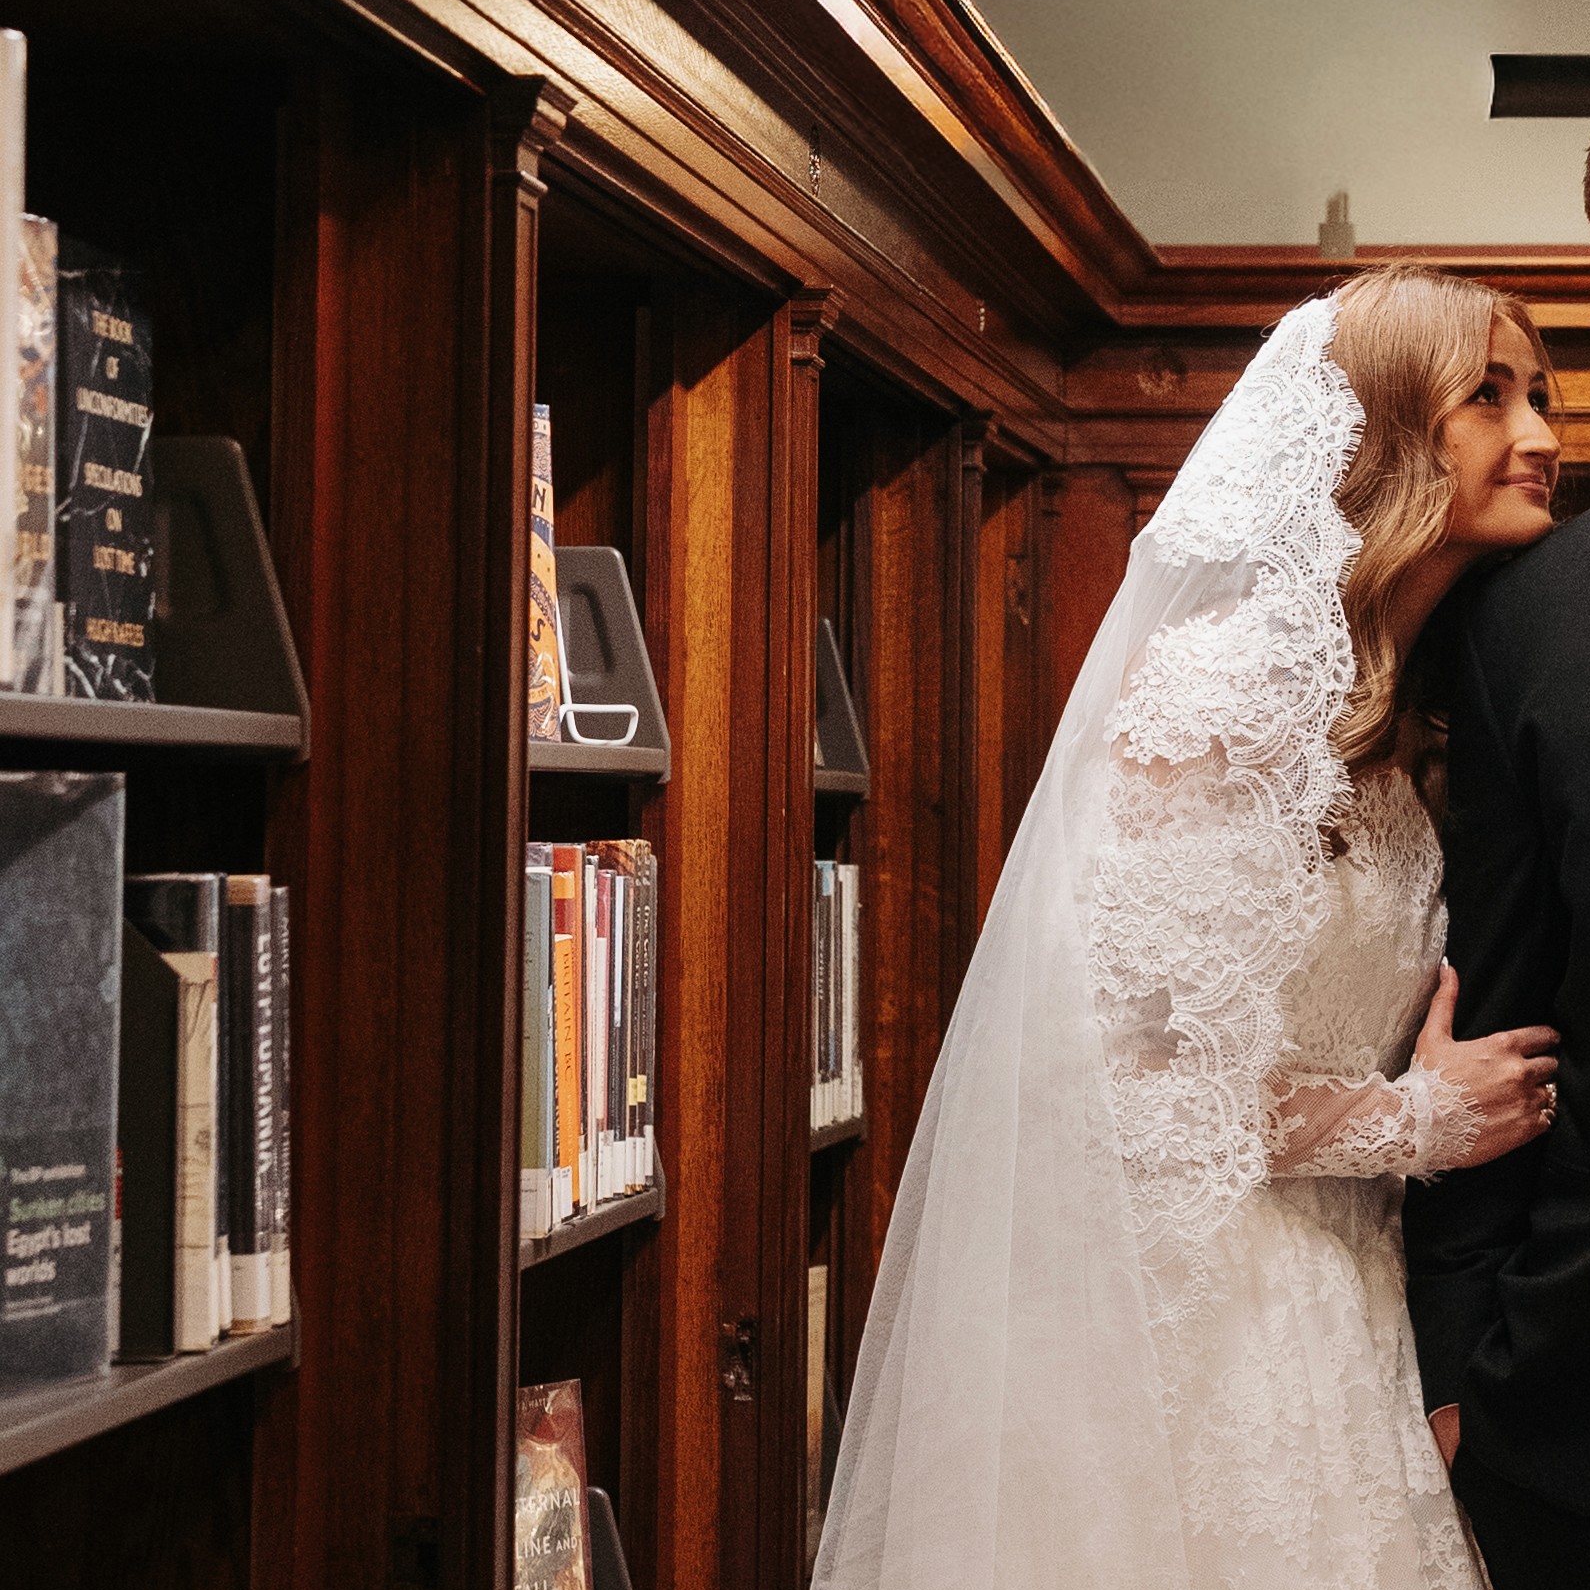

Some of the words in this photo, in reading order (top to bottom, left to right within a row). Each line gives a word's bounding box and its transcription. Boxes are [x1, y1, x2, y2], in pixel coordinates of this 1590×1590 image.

[563, 953, 573, 1043] BRITAIN
[6, 1258, 57, 1286] worlds
[555, 1539, 579, 1552] AND
